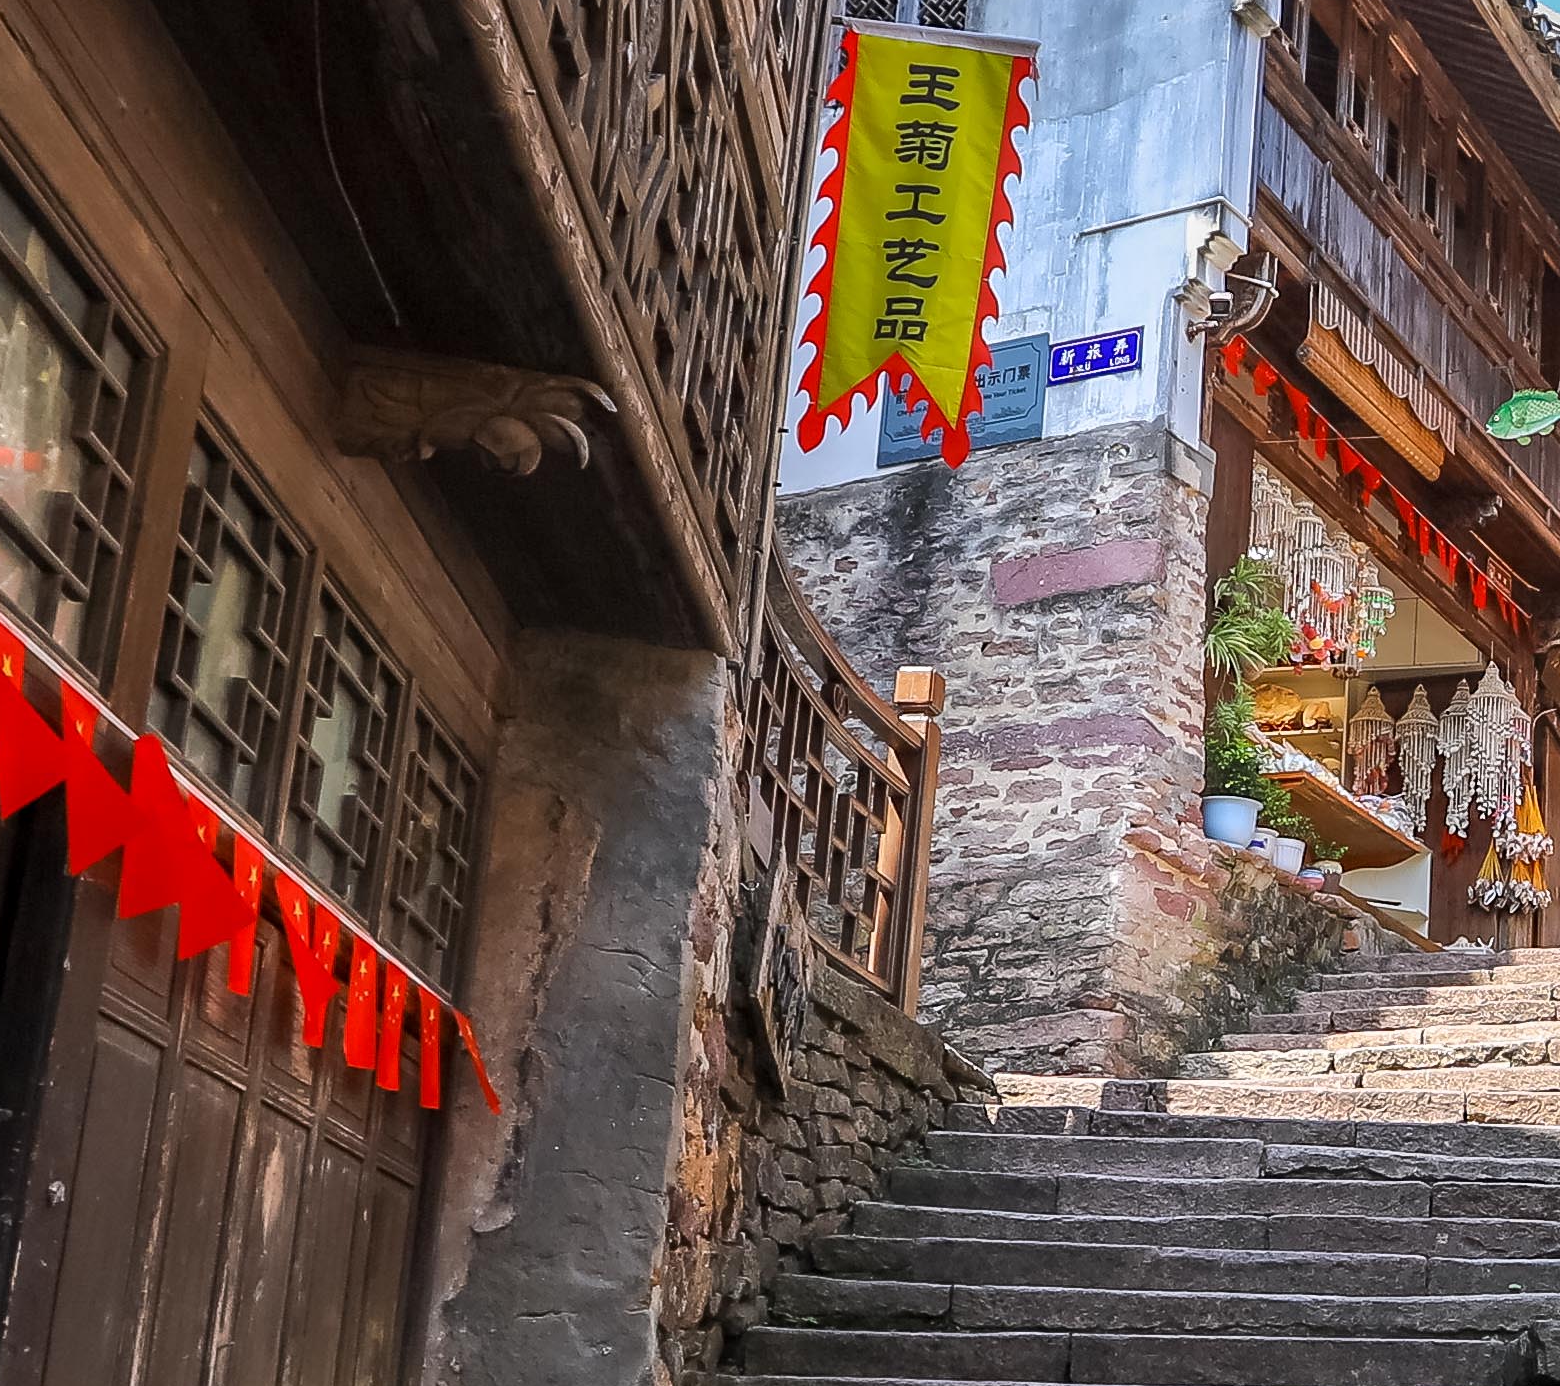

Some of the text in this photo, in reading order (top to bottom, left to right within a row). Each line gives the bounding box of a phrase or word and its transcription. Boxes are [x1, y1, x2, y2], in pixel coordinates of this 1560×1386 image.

[873, 63, 961, 343] 王菊工艺品
[1109, 354, 1131, 367] LONG
